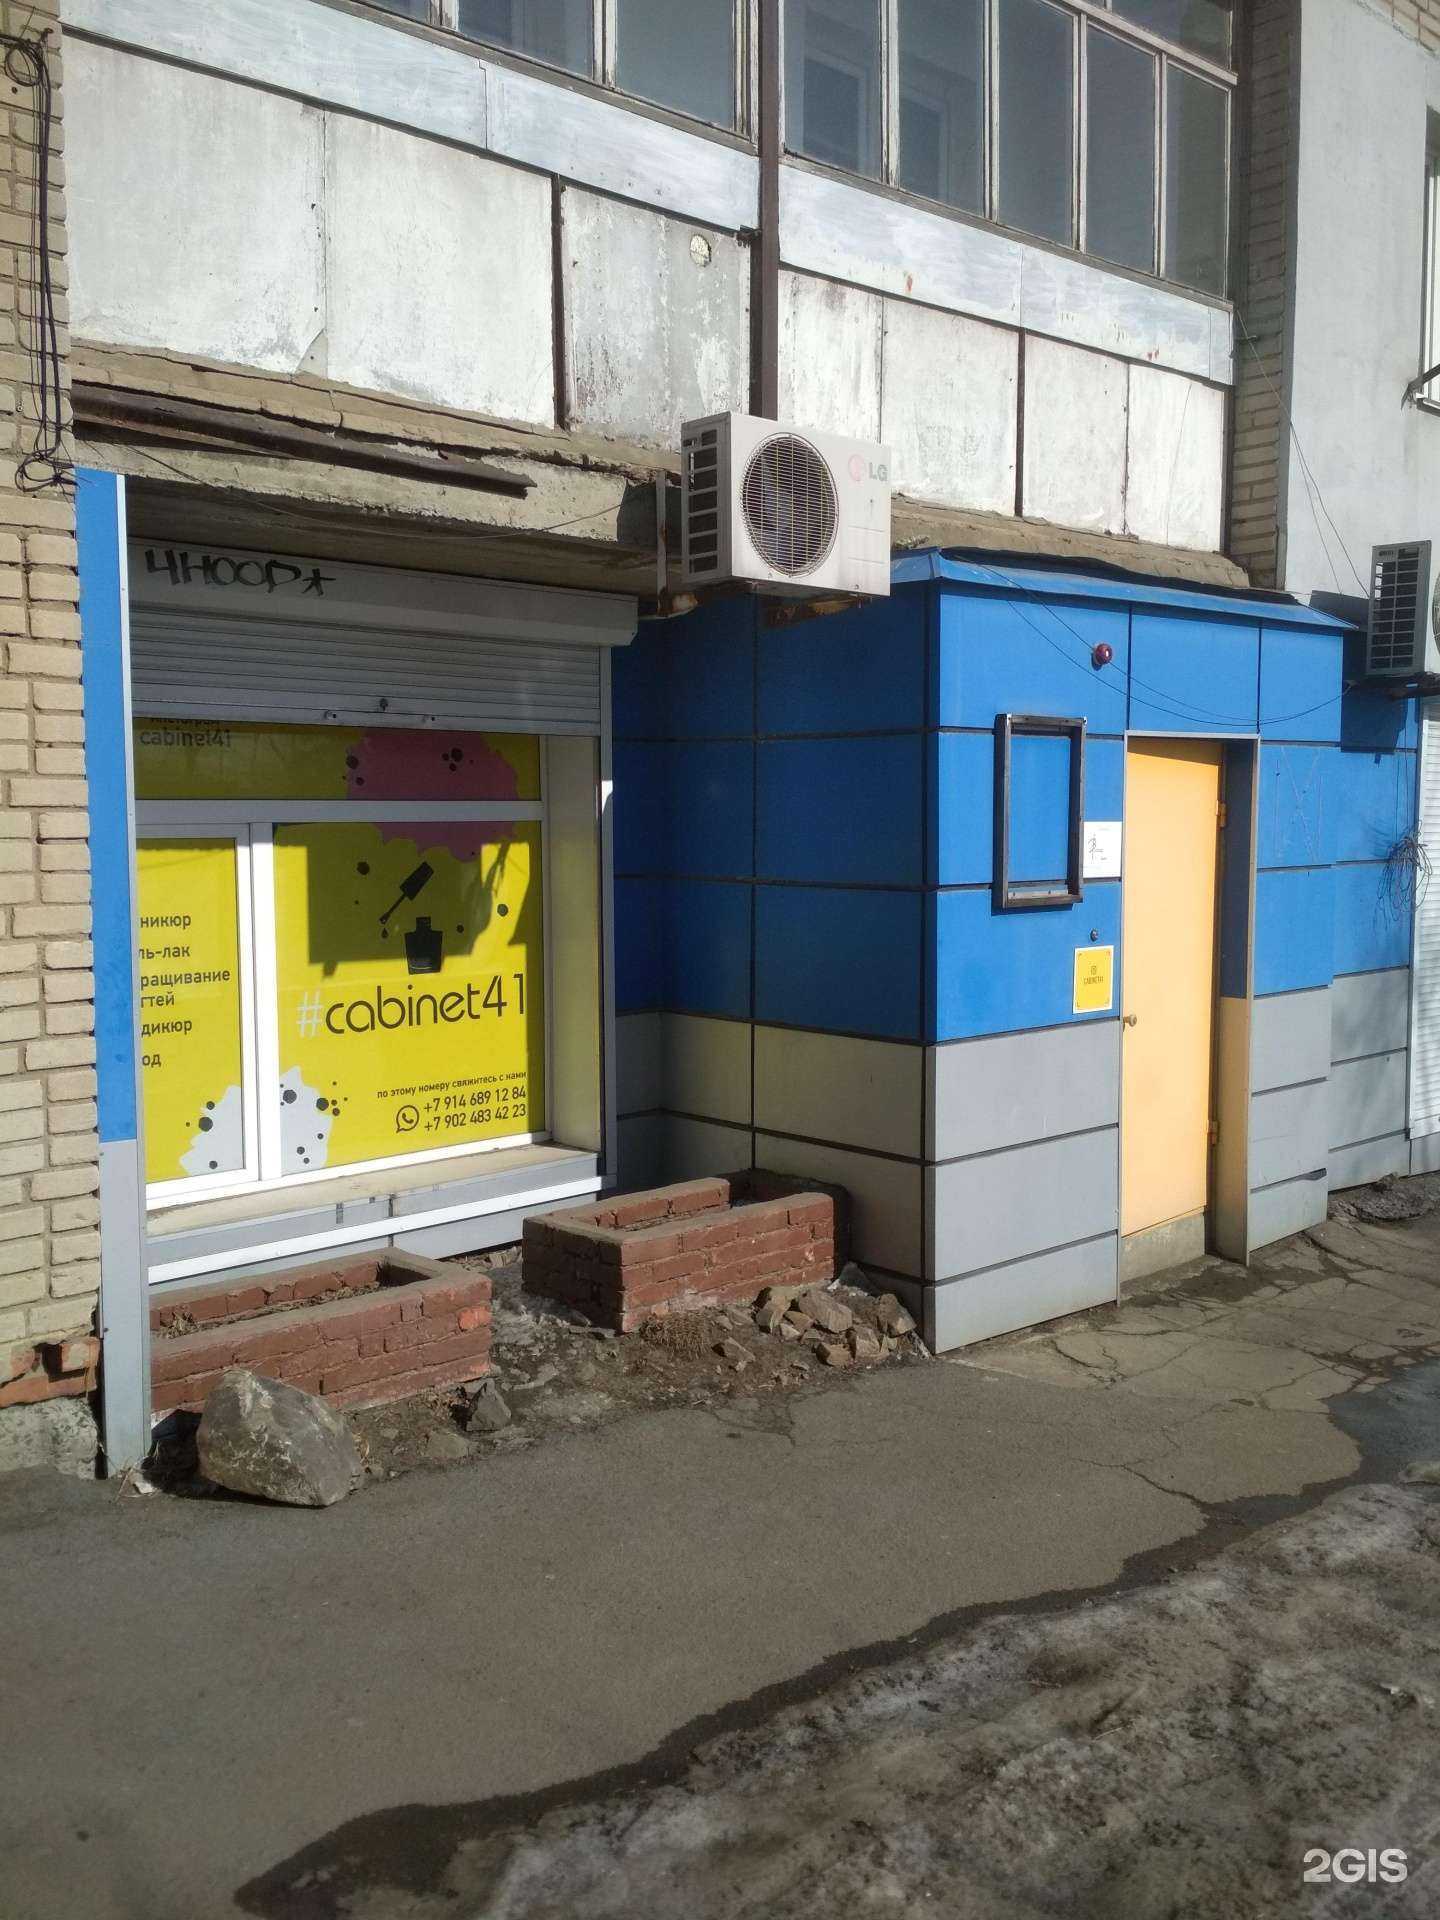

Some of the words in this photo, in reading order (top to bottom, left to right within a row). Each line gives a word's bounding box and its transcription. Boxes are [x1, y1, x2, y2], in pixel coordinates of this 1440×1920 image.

[868, 462, 888, 482] LG
[140, 726, 231, 748] cabinet41
[140, 914, 192, 930] никюр
[140, 969, 231, 990] ращивание
[296, 973, 525, 1038] #cabinet41
[141, 1019, 193, 1038] дикюр
[142, 1053, 162, 1068] од
[377, 1088, 389, 1099] по
[391, 1086, 417, 1098] этому
[418, 1081, 450, 1094] номеру
[452, 1076, 498, 1089] свяжитесь
[499, 1074, 504, 1082] с
[506, 1071, 527, 1081] нами
[424, 1098, 441, 1113] +7
[444, 1094, 467, 1109] 914
[470, 1090, 491, 1106] 689
[496, 1087, 509, 1102] 12
[512, 1085, 526, 1099] 84
[424, 1116, 441, 1132] +7
[445, 1112, 467, 1129] 902
[470, 1108, 492, 1125] 483
[495, 1105, 509, 1120] 42
[512, 1103, 527, 1118] 23
